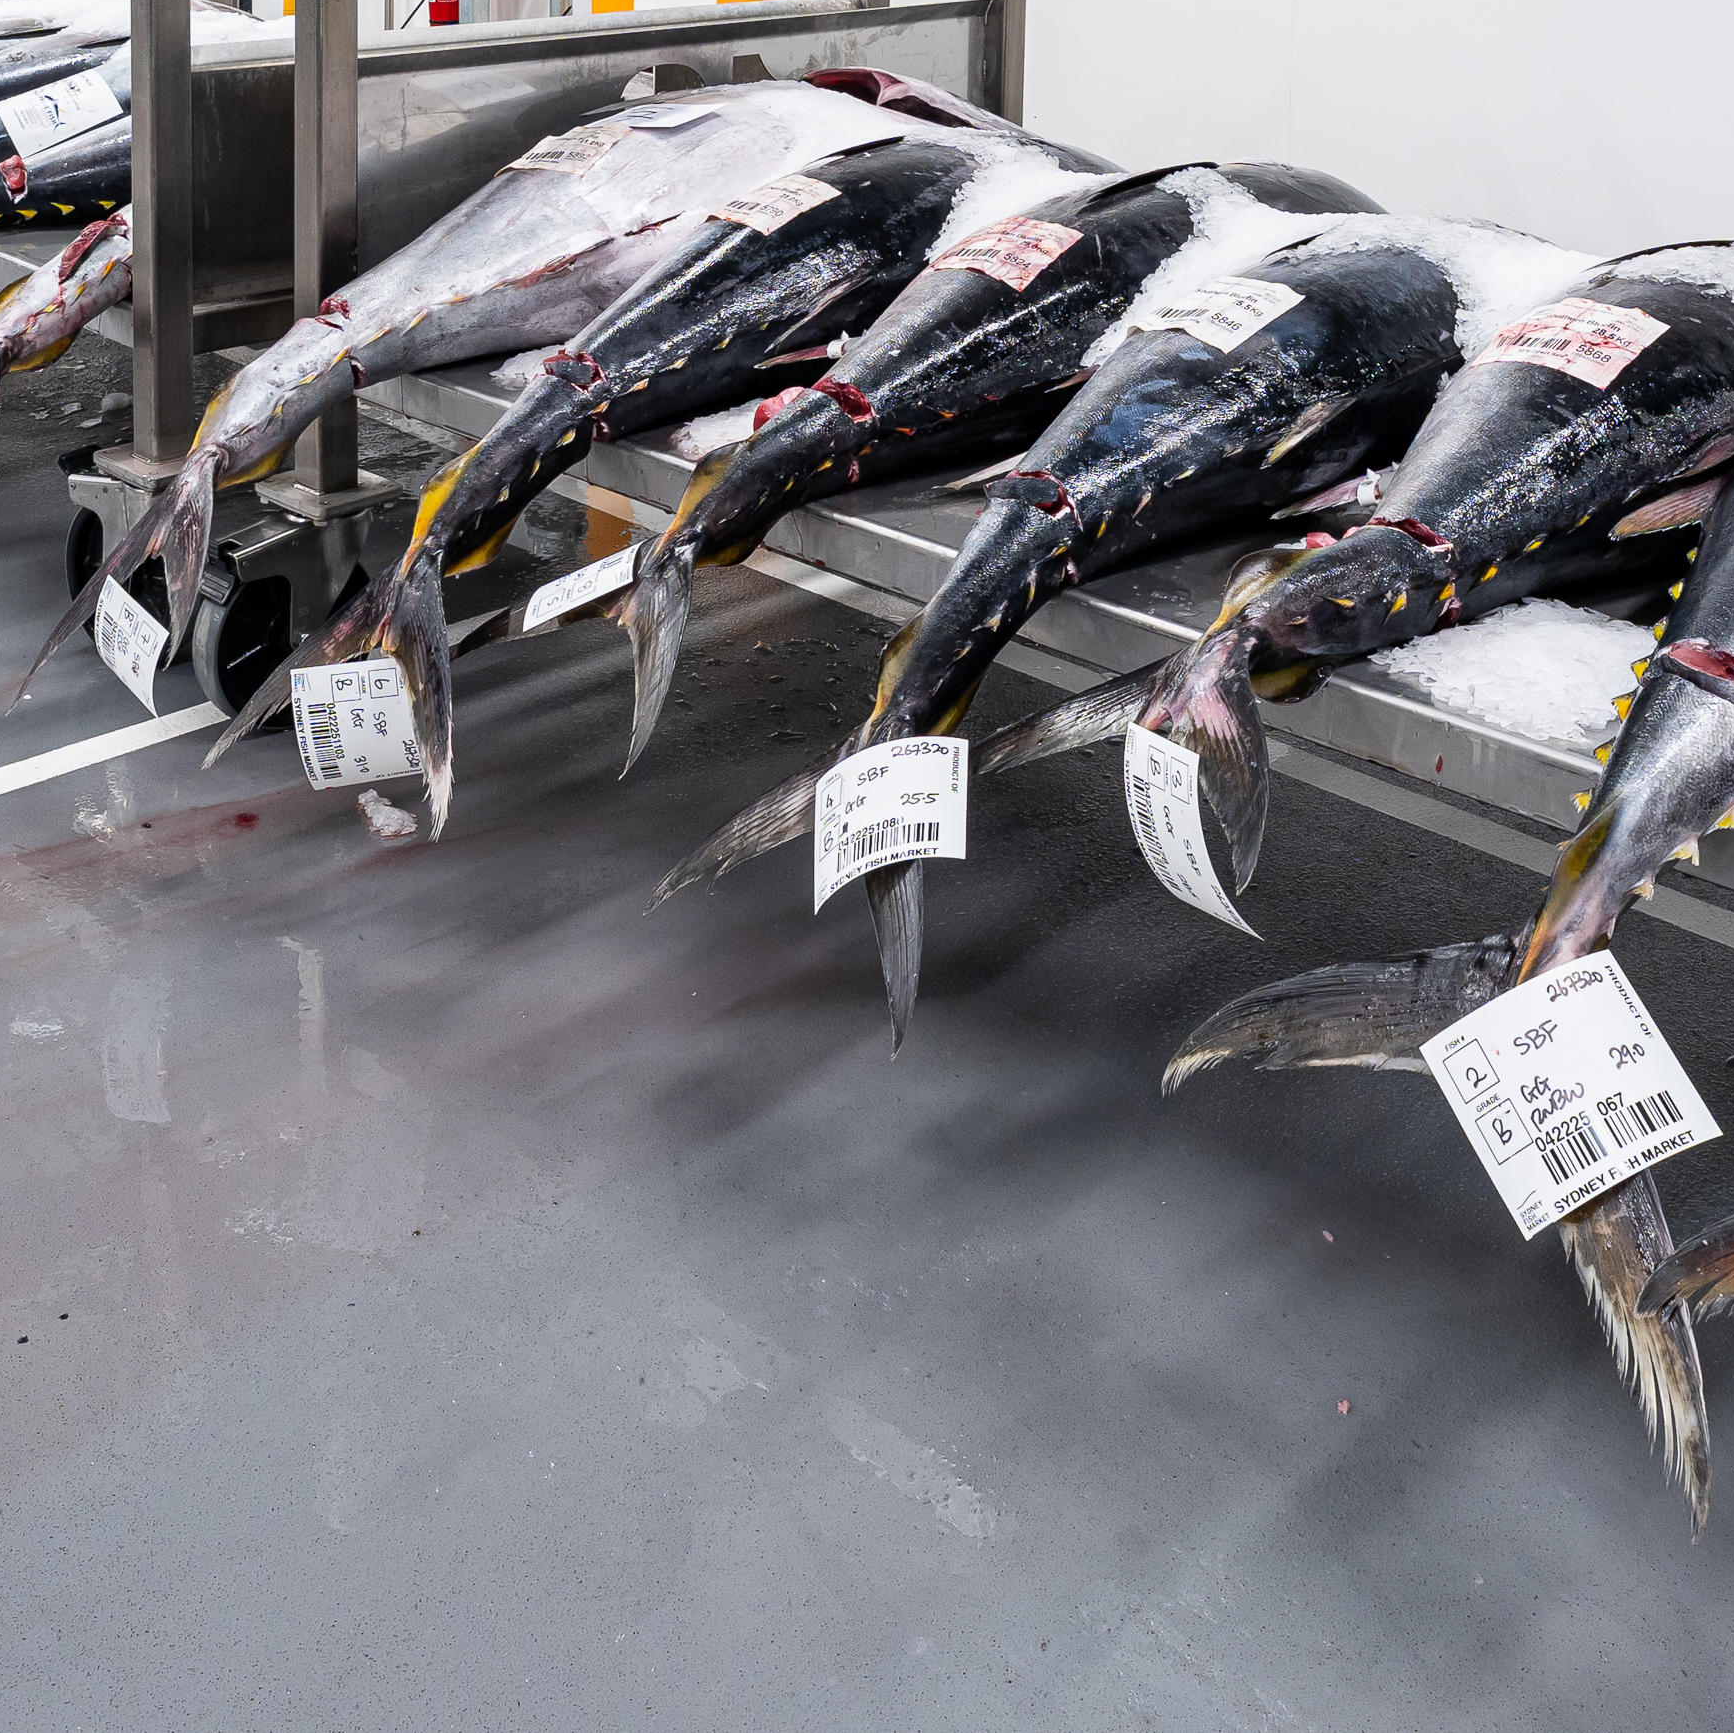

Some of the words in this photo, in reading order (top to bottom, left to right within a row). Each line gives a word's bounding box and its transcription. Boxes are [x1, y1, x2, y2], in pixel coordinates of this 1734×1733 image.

[761, 205, 783, 216] 5790
[1003, 252, 1031, 268] 5824
[1229, 293, 1258, 304] Bluefin
[1211, 313, 1242, 331] 5846
[1586, 319, 1621, 332] Bluefin
[1575, 345, 1613, 363] 5868
[141, 634, 152, 645] 7
[335, 678, 352, 691] B
[374, 678, 390, 690] 6
[293, 697, 305, 734] SYDNEY
[373, 712, 388, 738] SBF
[326, 703, 345, 760] 0422251103
[299, 736, 310, 755] FISH
[891, 742, 949, 758] 267320
[303, 755, 319, 782] MARKET
[951, 746, 960, 782] PRODUCT
[1149, 754, 1162, 777] B
[857, 766, 889, 786] SBF
[1171, 770, 1182, 789] 3
[951, 783, 959, 794] OF
[1125, 760, 1133, 811] SYDNEY
[1130, 812, 1141, 840] FISH
[1183, 838, 1203, 877] SBF
[830, 867, 863, 893] SYDNEY
[865, 856, 888, 870] FISH
[890, 847, 939, 861] MARKET
[1546, 970, 1603, 1002] 267320
[1605, 965, 1642, 1022] PRODUCT
[1639, 1022, 1655, 1040] OF
[1444, 1037, 1461, 1052] FISH
[1513, 1018, 1558, 1056] SBF
[1465, 1066, 1488, 1088] 2
[1475, 1093, 1501, 1114] GRADE
[1535, 1092, 1625, 1153] 042225067
[1553, 1173, 1608, 1215] SYDNEY
[1641, 1129, 1696, 1163] MARKET
[1519, 1200, 1543, 1218] SYDNEY
[1523, 1211, 1539, 1225] FISH
[1526, 1212, 1551, 1232] MARKET
